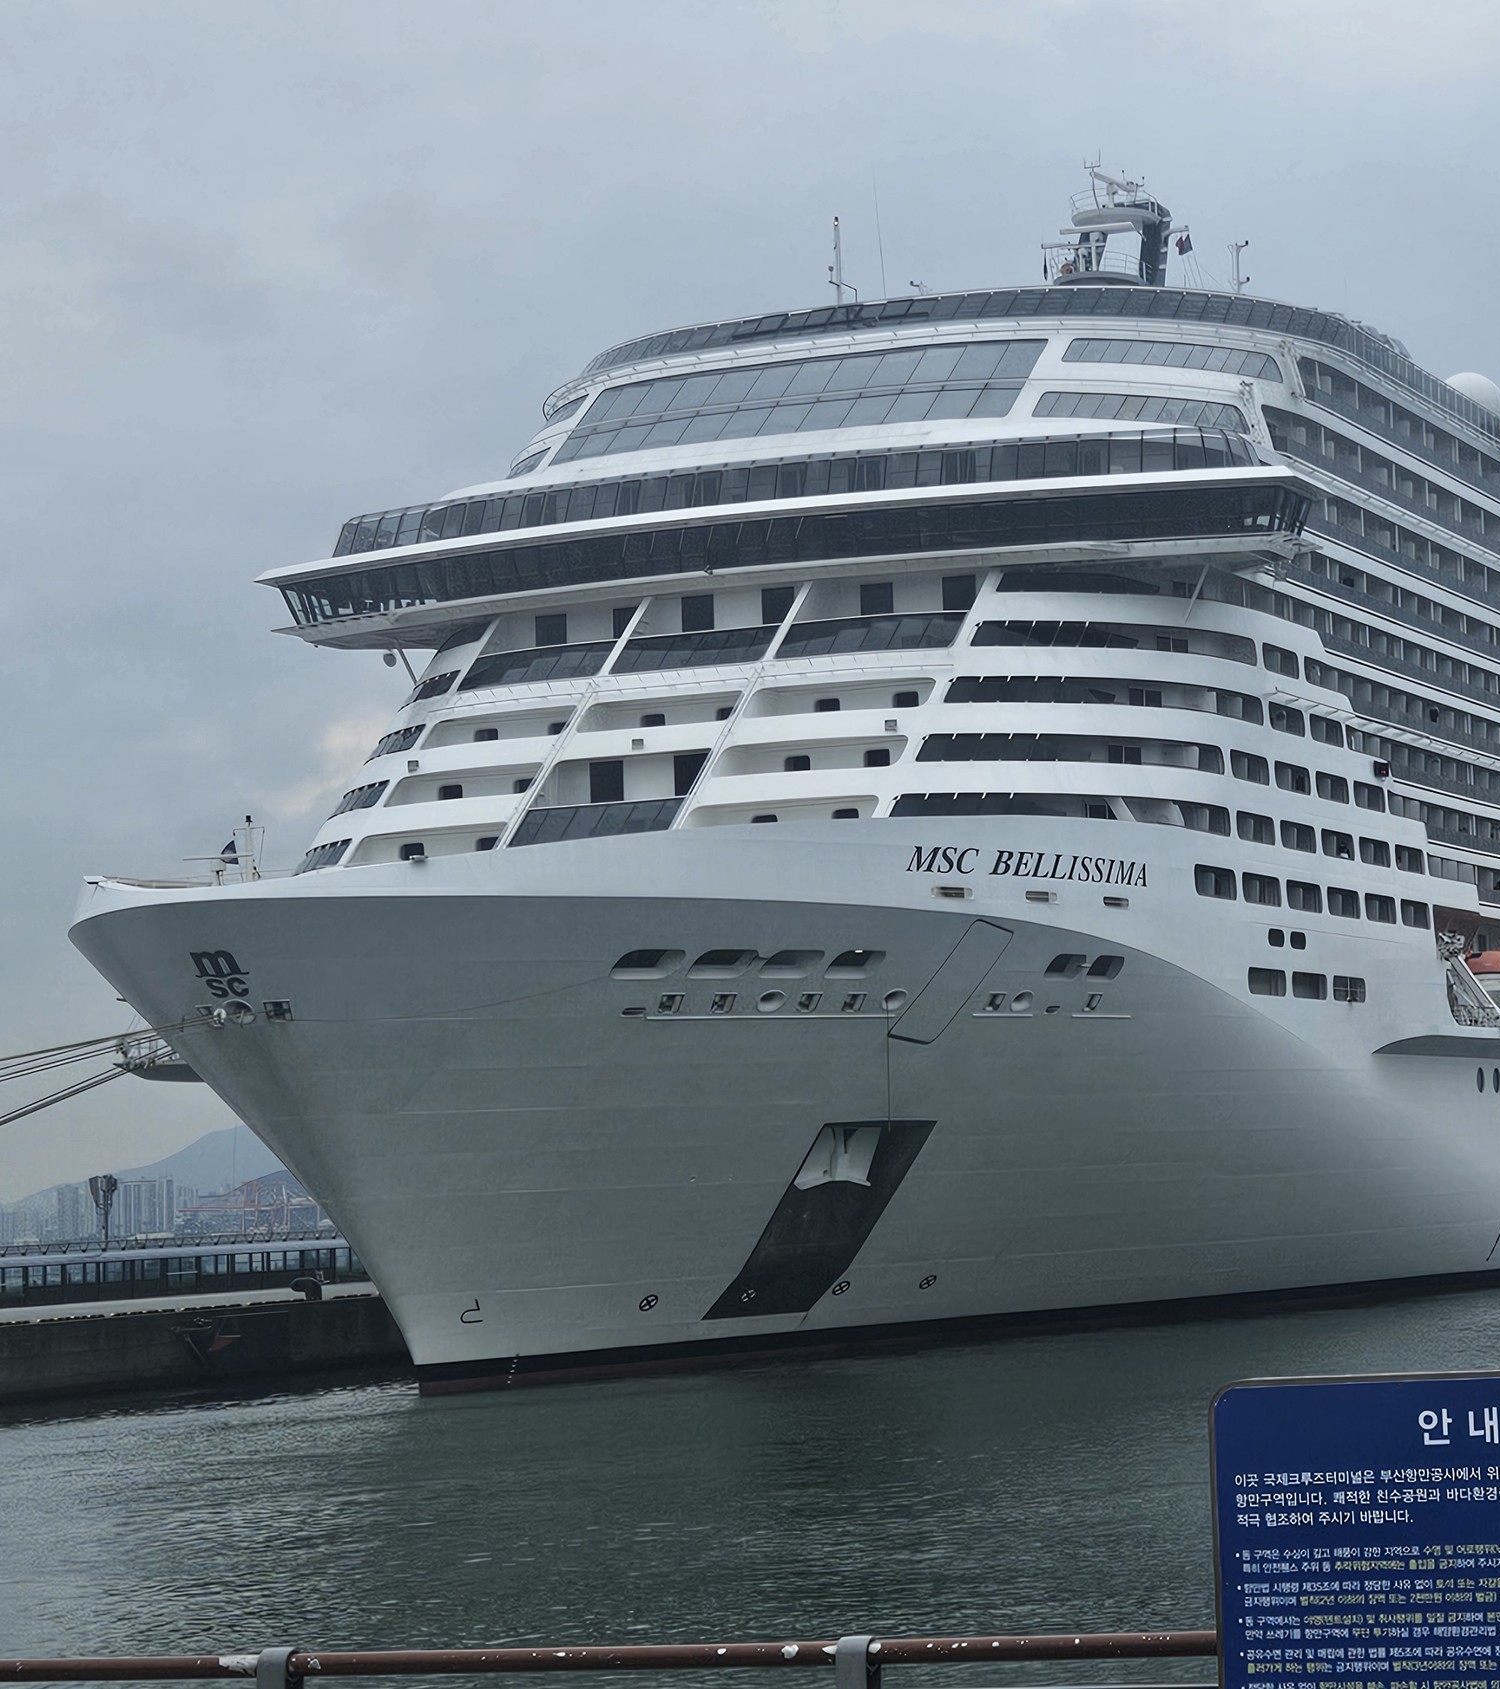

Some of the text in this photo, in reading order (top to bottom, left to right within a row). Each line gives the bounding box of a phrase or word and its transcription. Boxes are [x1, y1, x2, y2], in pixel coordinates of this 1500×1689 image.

[905, 845, 1148, 888] MSC BELLISSIMA
[1235, 1474, 1258, 1487] 이곳
[1264, 1470, 1375, 1486] 국제크루즈터미널은
[1236, 1492, 1327, 1508] 항만구역입니다.
[1334, 1490, 1370, 1504] 쾌적한
[1377, 1488, 1440, 1503] 친수공원과
[1237, 1510, 1413, 1527] 적극 협조하여 주시기 바랍니다.
